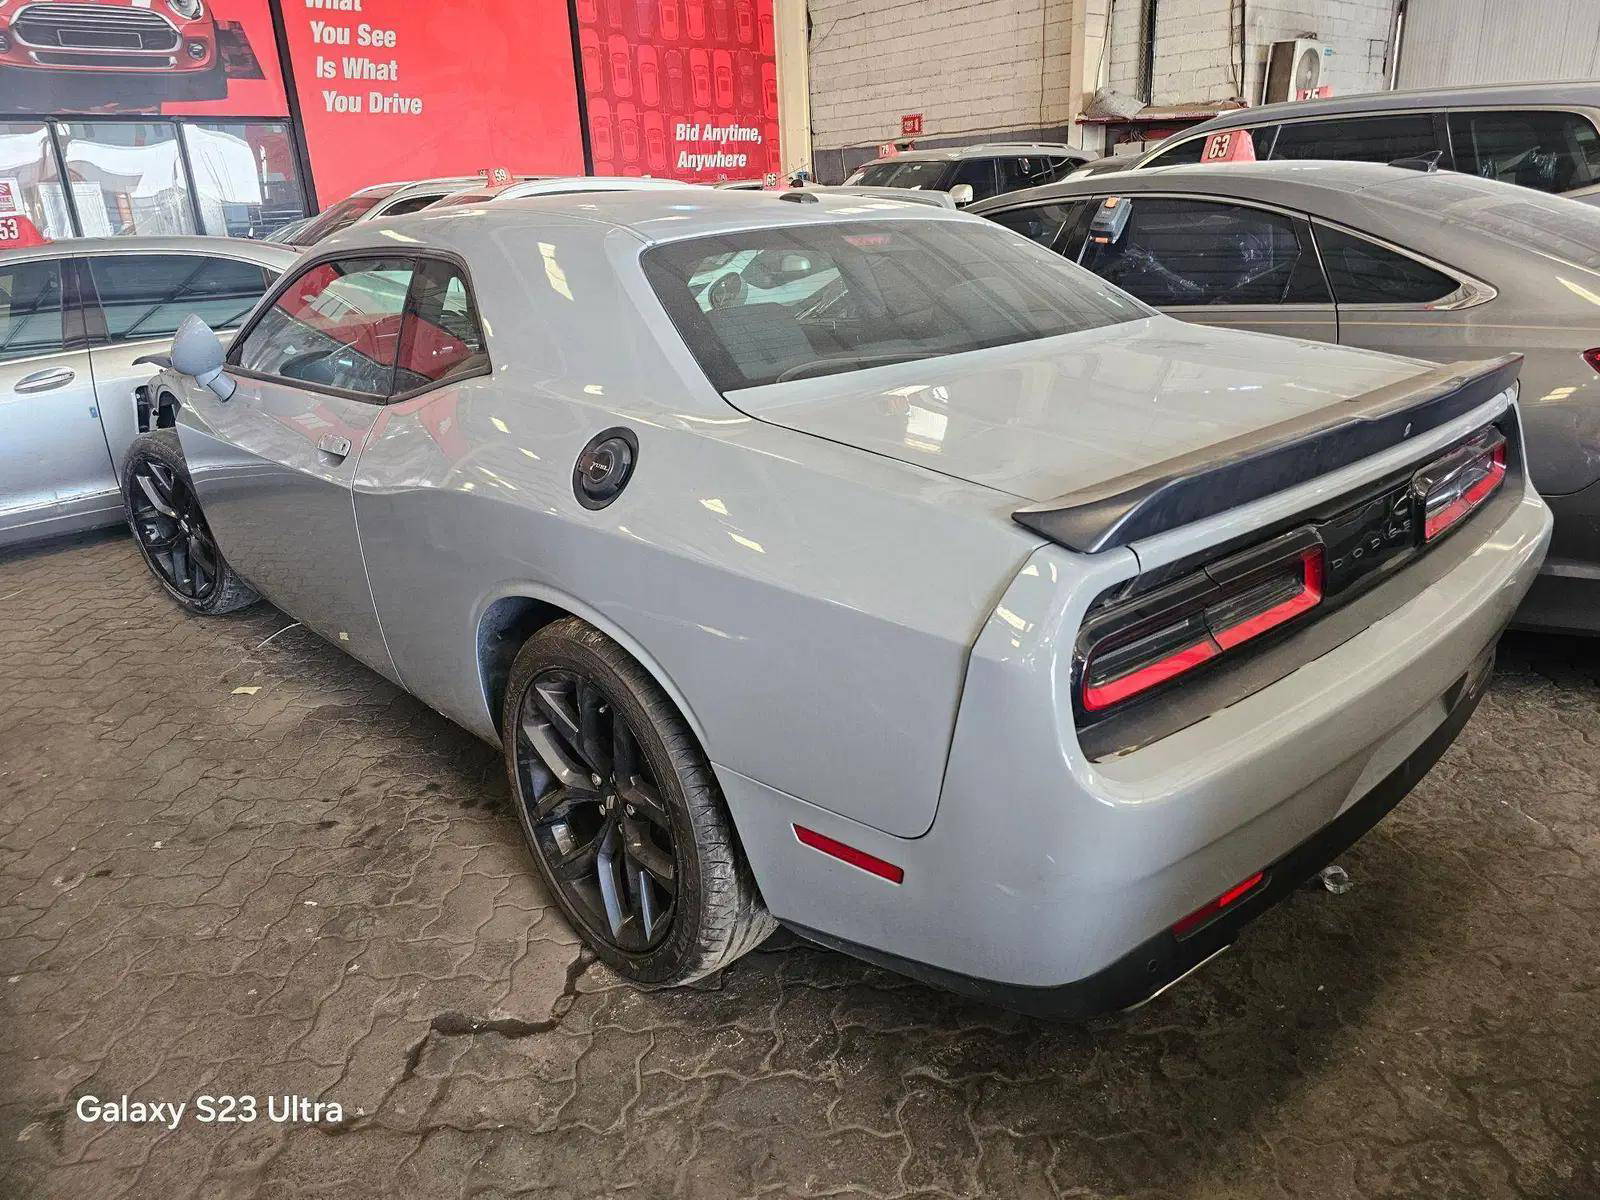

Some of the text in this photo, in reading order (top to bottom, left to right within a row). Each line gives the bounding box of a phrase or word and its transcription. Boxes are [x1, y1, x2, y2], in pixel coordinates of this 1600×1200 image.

[310, 20, 397, 48] You See
[316, 56, 398, 81] Is What
[322, 90, 423, 115] You Drive
[675, 123, 762, 144] Bid Anytime,
[1208, 134, 1232, 159] 63
[677, 150, 747, 171] Anywhere
[0, 218, 19, 240] 53
